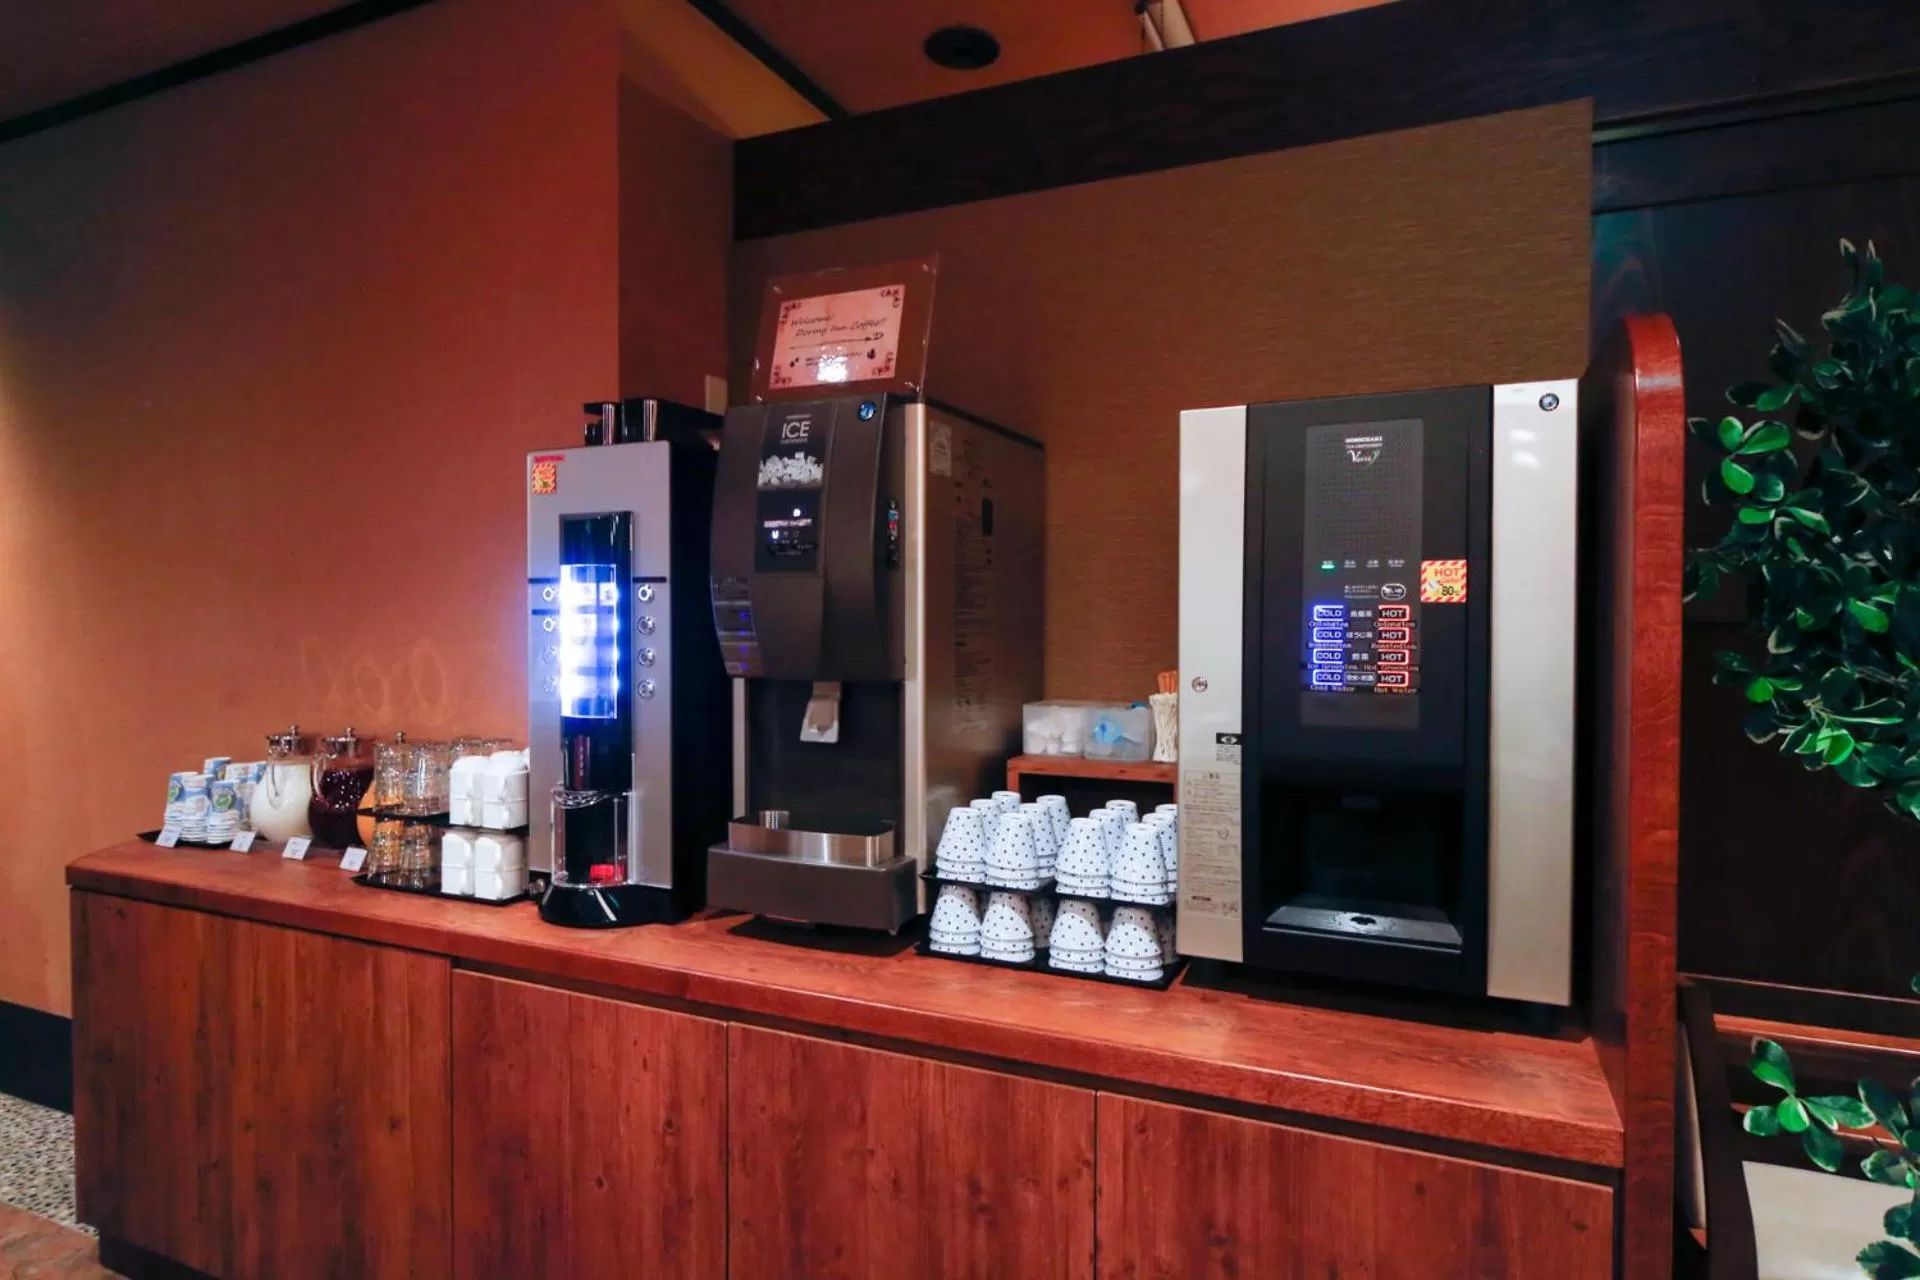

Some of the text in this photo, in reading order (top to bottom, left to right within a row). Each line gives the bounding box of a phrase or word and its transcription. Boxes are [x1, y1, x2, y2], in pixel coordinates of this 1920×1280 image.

[782, 421, 811, 439] ICE
[1434, 568, 1463, 577] HOT
[1381, 610, 1404, 618] HOT
[1381, 631, 1403, 639] HOT
[1316, 652, 1341, 660] COLD
[1381, 653, 1403, 661] HOT
[1316, 673, 1341, 681] COLD
[1381, 675, 1403, 683] HOT
